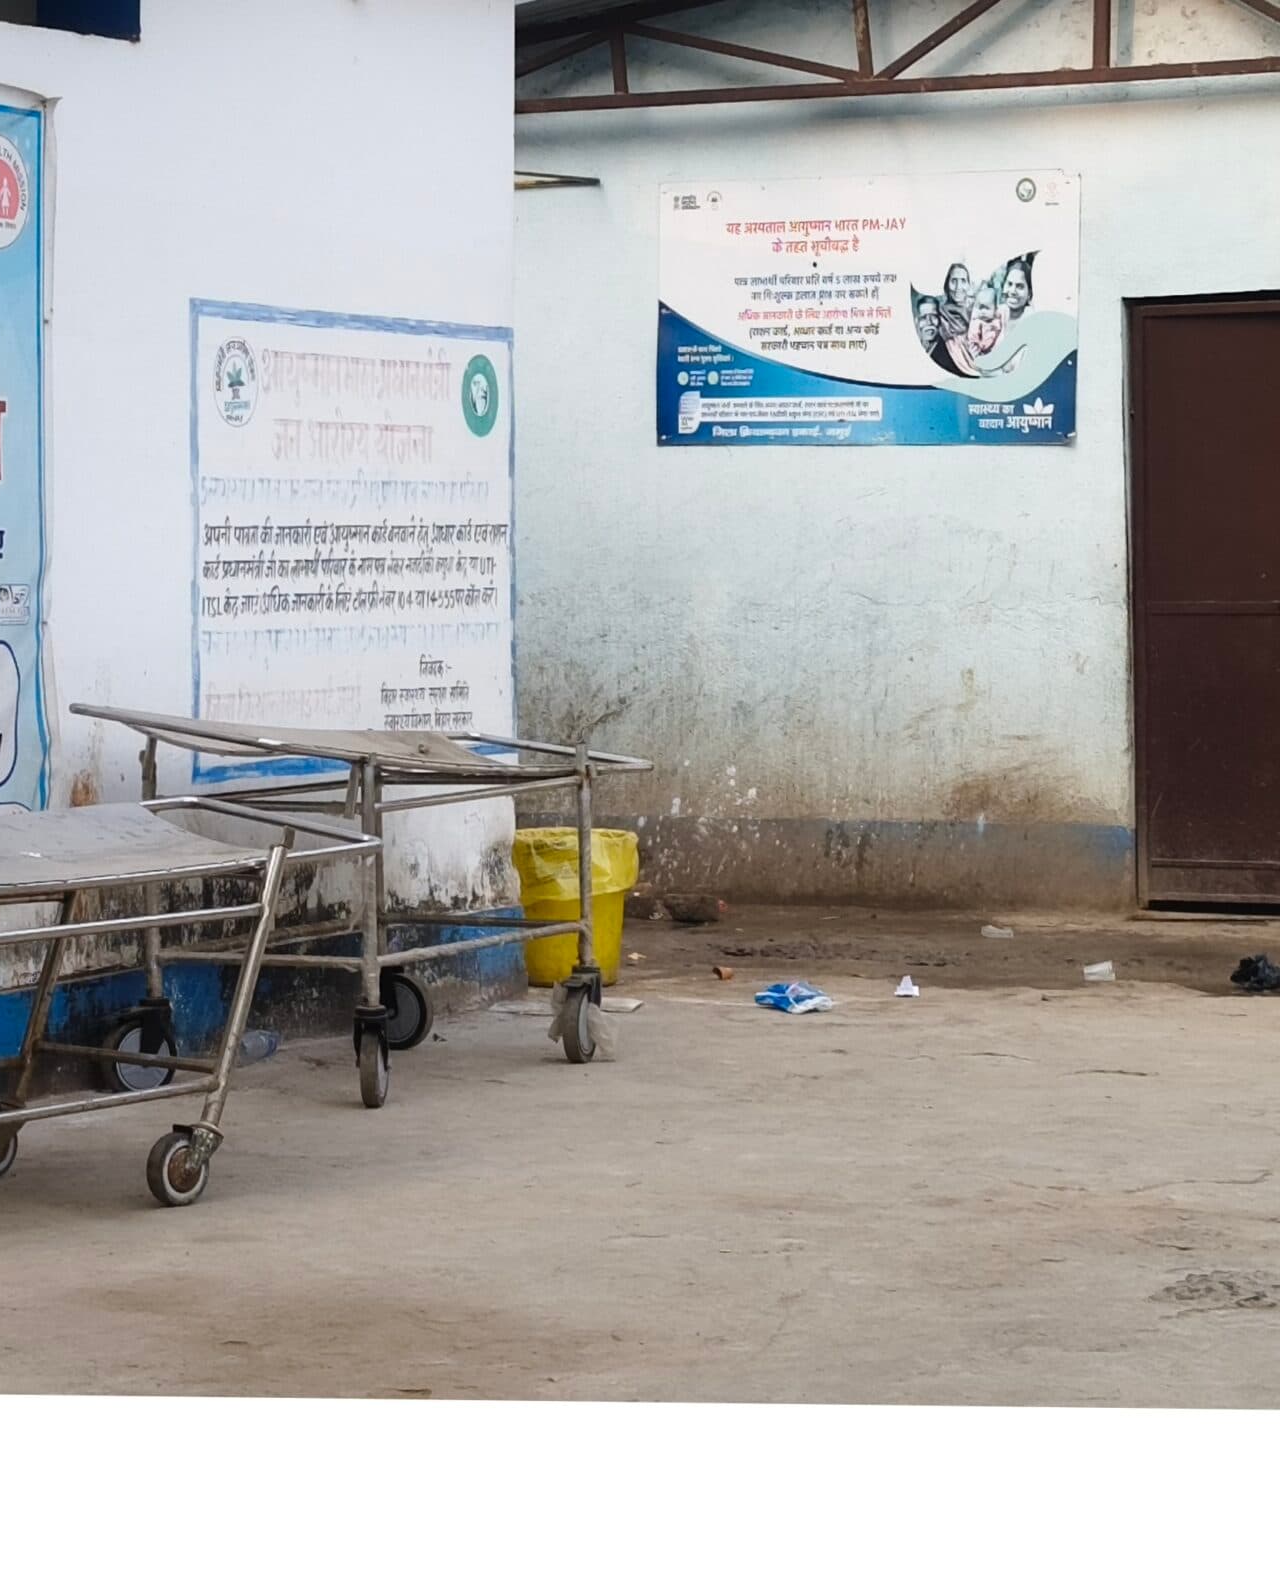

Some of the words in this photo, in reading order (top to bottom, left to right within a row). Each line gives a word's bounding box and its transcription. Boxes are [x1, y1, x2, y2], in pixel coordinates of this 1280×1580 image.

[12, 160, 27, 211] MISSION
[726, 222, 741, 235] यह
[744, 220, 785, 234] अस्पताल
[789, 219, 831, 236] आयुष्मान
[835, 218, 859, 232] भारत
[862, 217, 906, 232] PM-JAY
[772, 237, 783, 253] के
[785, 240, 808, 253] तहत
[1006, 415, 1053, 433] आयुष्मान
